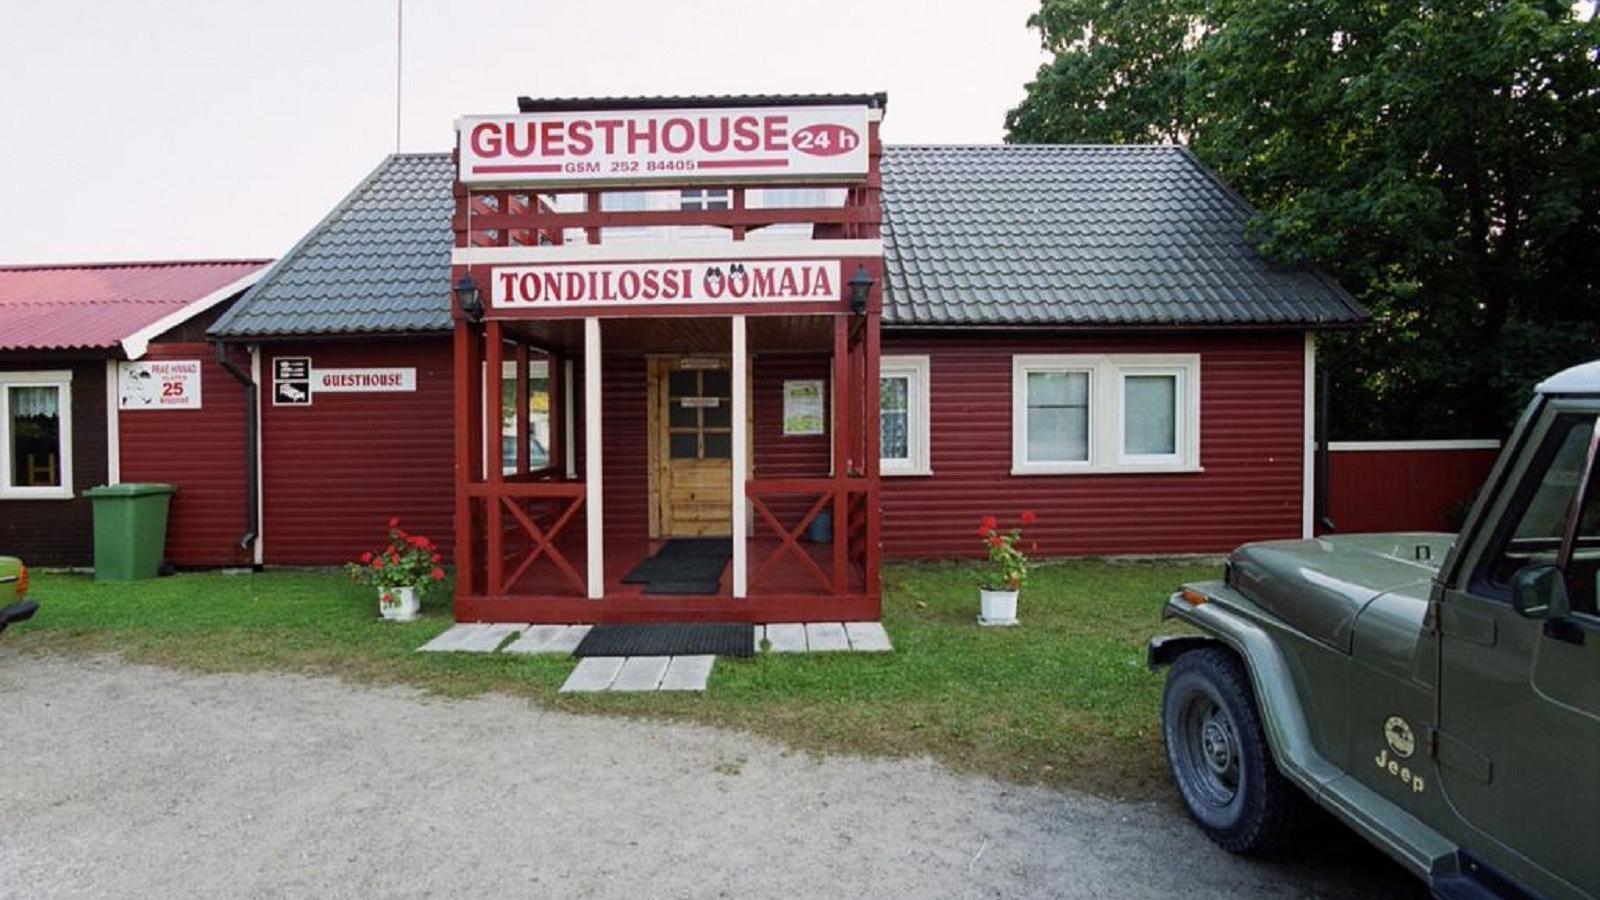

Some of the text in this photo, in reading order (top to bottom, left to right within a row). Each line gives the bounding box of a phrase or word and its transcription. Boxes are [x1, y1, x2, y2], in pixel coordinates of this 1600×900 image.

[470, 115, 857, 158] GUESTHOUSE 24 h
[564, 158, 697, 173] GSM 252 84405
[500, 269, 693, 302] TONDILOSSI
[163, 382, 184, 397] 25
[322, 373, 403, 387] GUESTHOUSE
[1375, 750, 1424, 793] Jeep
